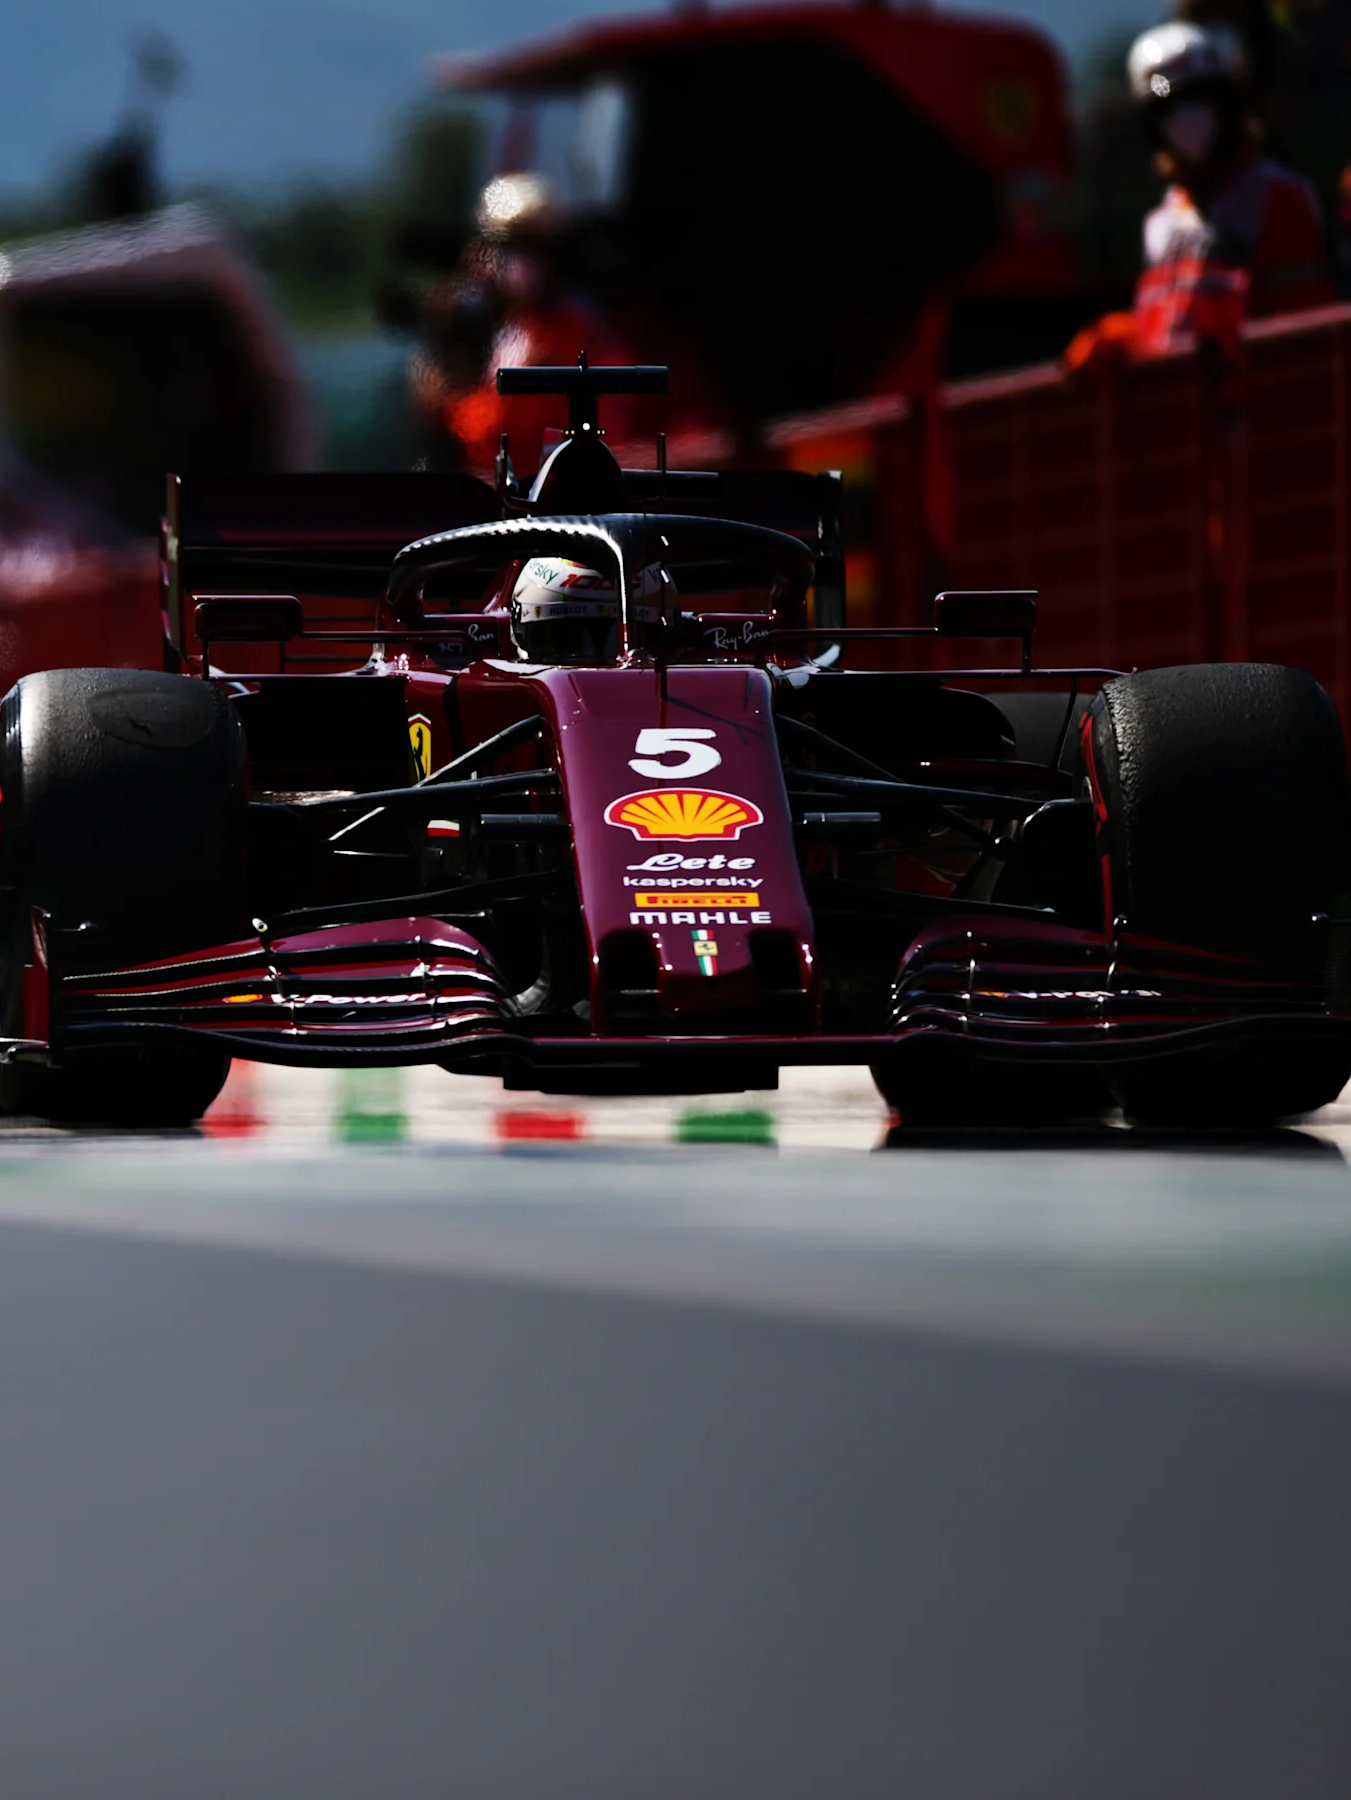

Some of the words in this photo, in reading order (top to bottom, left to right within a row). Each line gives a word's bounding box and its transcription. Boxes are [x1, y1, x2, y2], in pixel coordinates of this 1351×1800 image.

[549, 605, 587, 616] HUBLOT
[703, 620, 772, 651] Ray-Ban
[628, 728, 722, 779] 5
[626, 853, 755, 871] Lete
[623, 876, 763, 888] kaspersky
[629, 911, 772, 925] MAHLE
